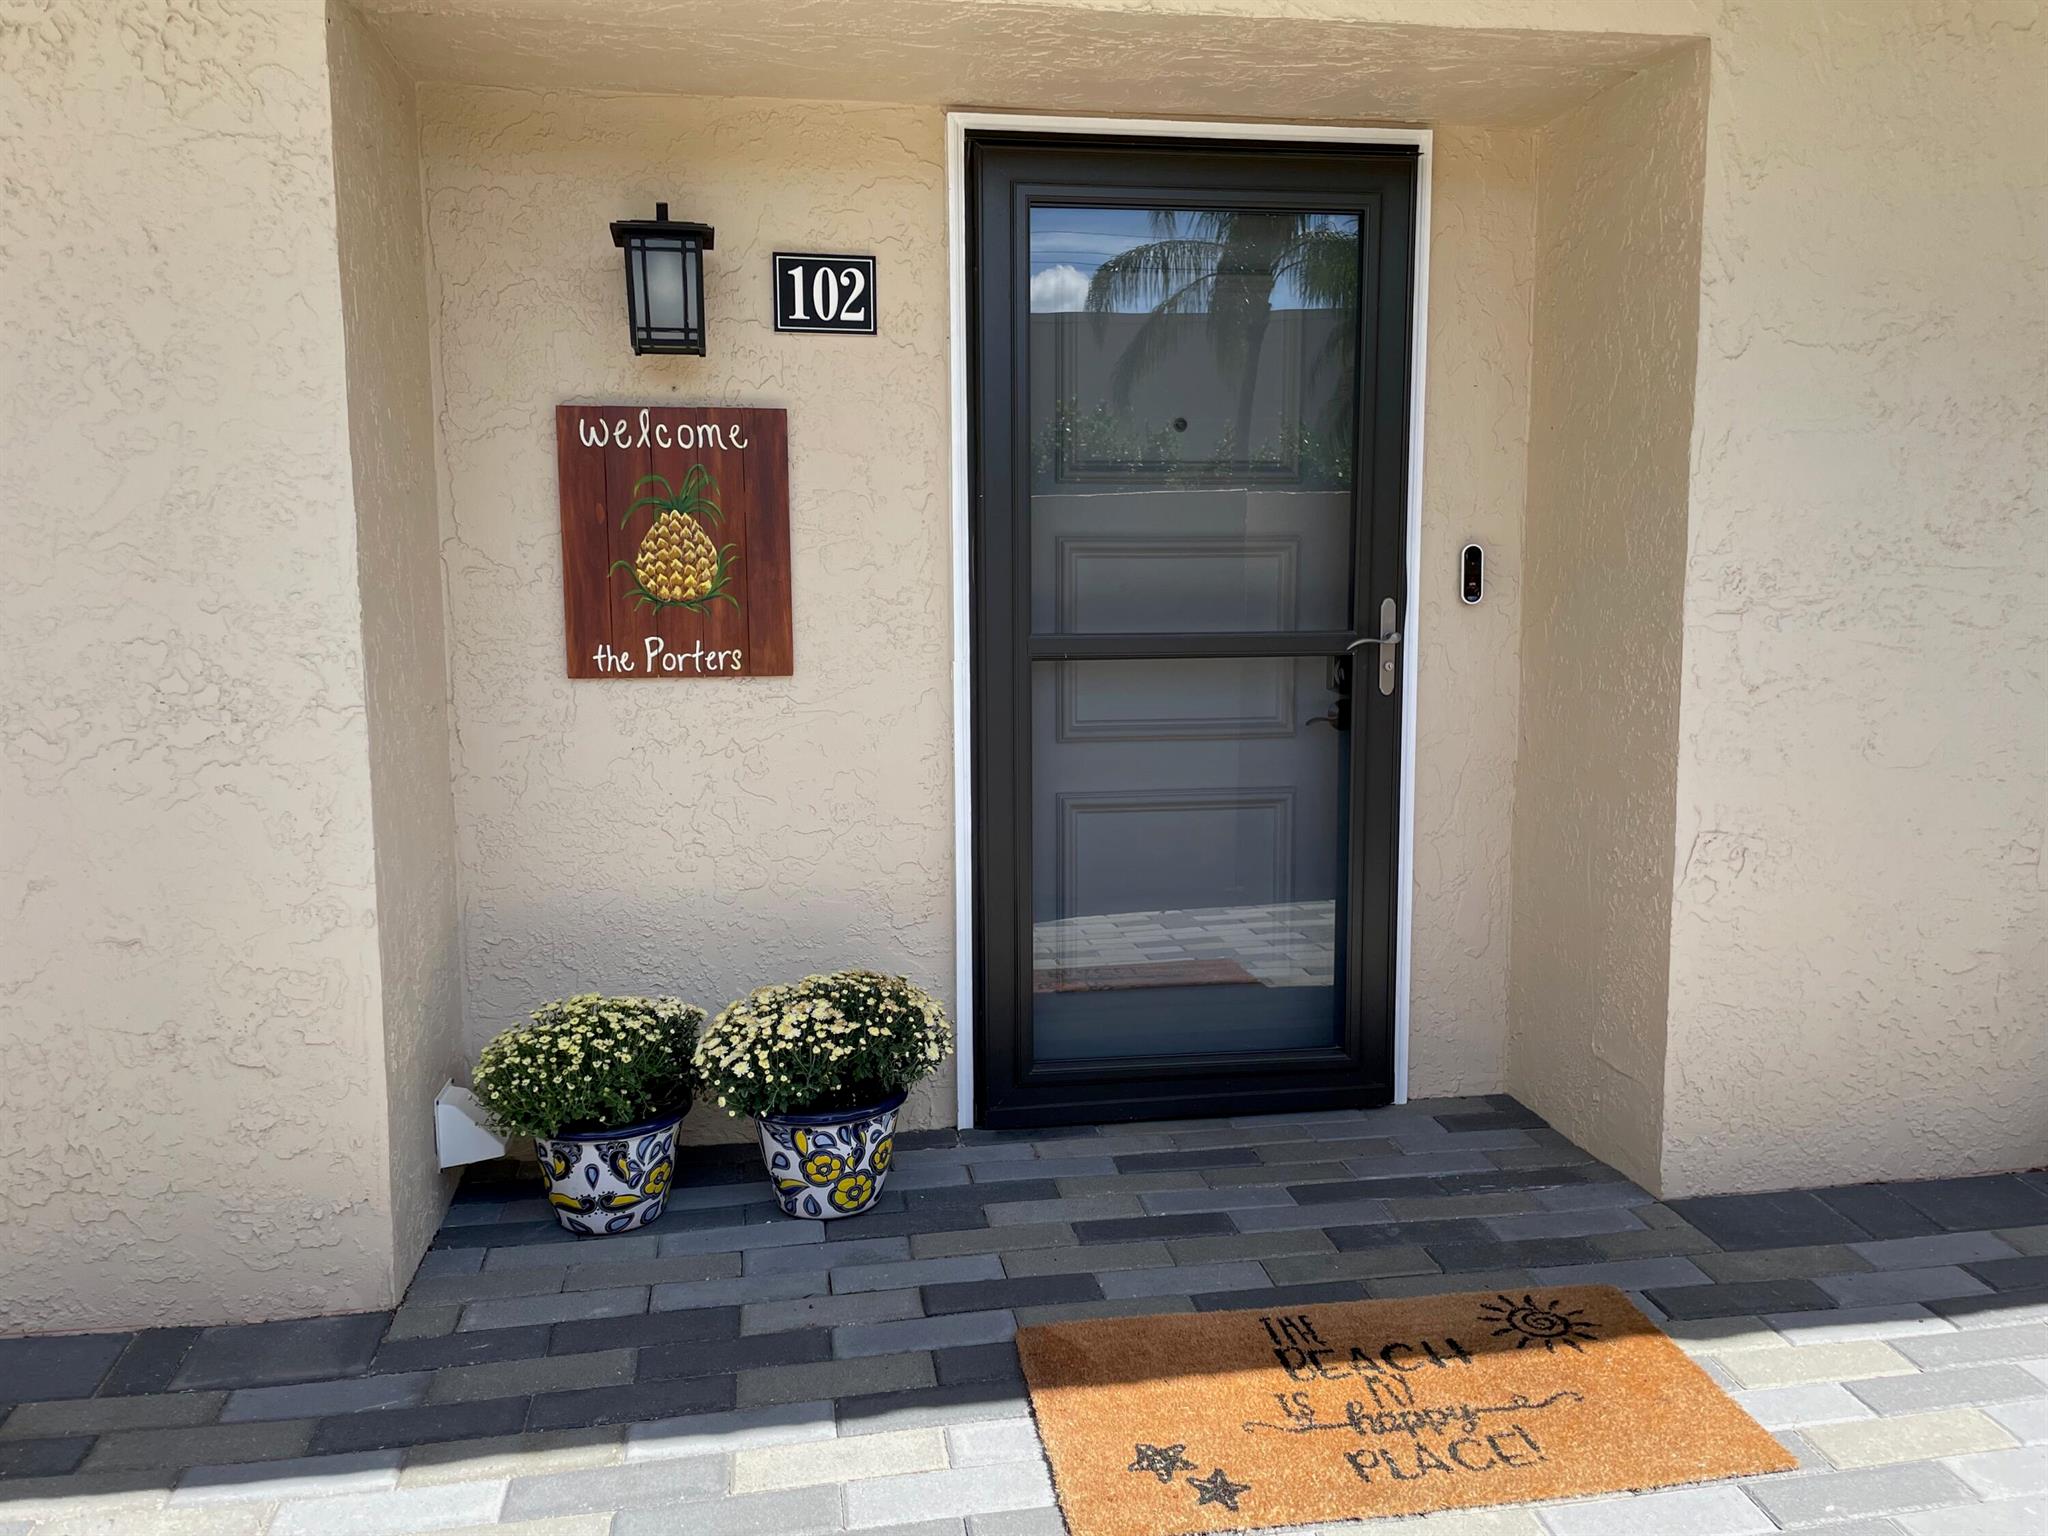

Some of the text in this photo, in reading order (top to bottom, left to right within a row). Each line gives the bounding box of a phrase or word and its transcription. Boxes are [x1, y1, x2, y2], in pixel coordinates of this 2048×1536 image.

[787, 266, 865, 321] 102
[579, 408, 748, 450] welcome
[593, 637, 743, 674] the Porters
[1259, 1315, 1327, 1346] THE
[1273, 1338, 1472, 1382] BEACH
[1346, 1401, 1478, 1437] happy
[1344, 1424, 1548, 1483] PLACE!
